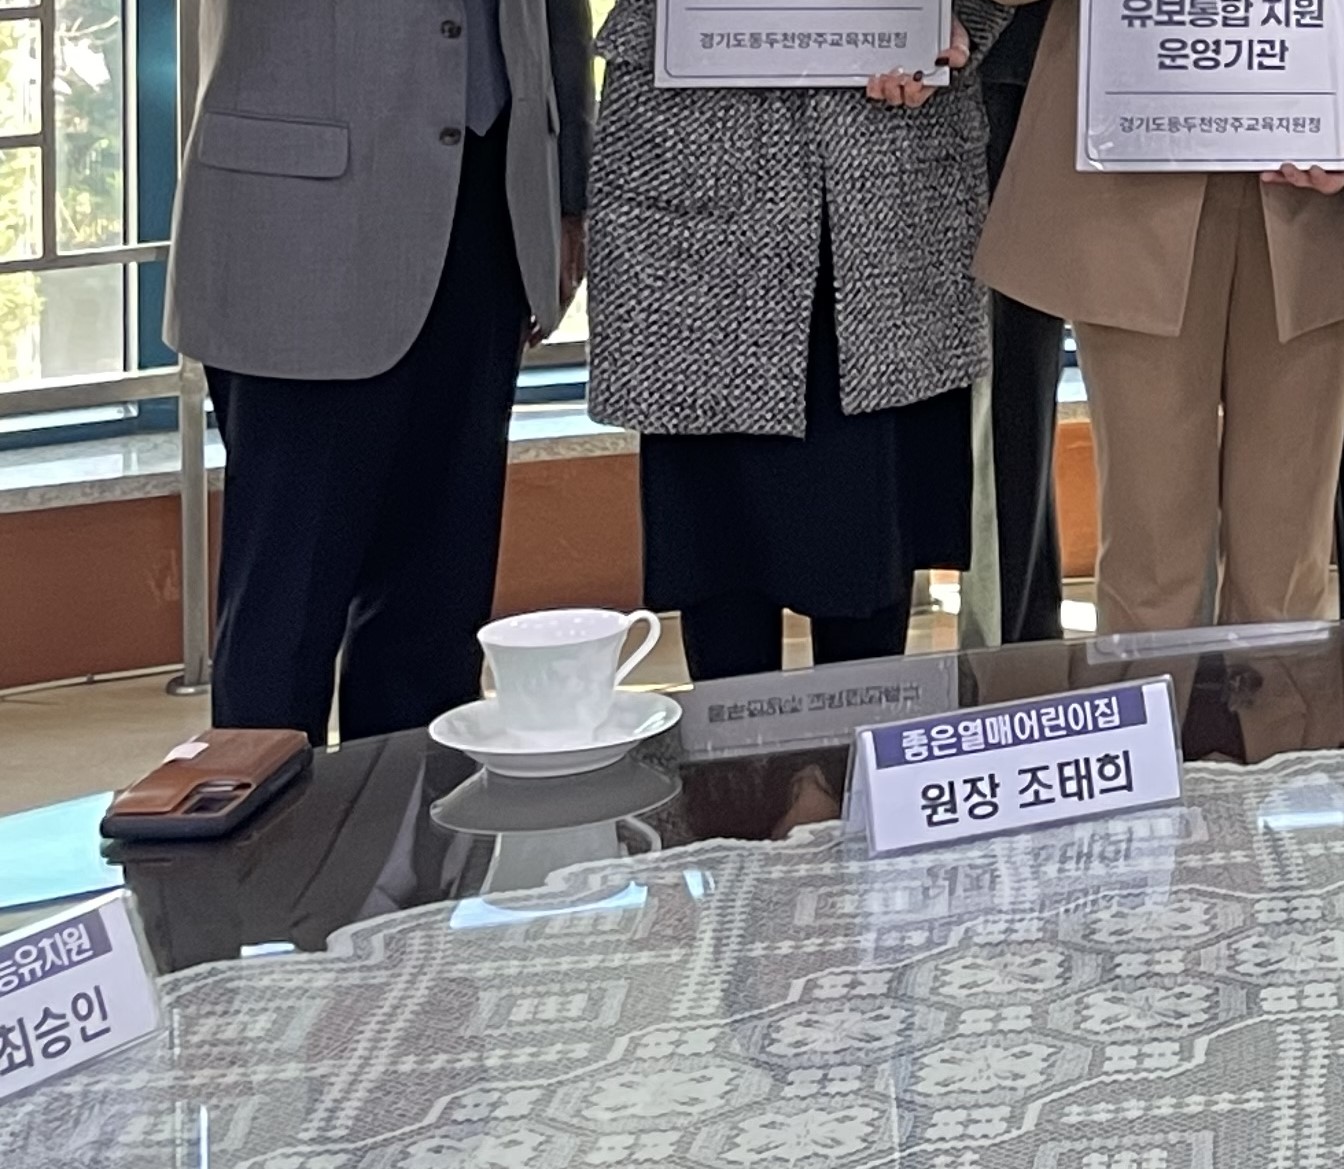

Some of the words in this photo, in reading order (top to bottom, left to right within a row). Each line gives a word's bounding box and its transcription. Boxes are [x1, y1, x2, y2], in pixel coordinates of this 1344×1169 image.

[700, 32, 908, 49] 경기도동두천양주교육지원청
[1157, 38, 1289, 71] 운영기관
[1119, 117, 1321, 133] 경기도동두천양주교육지원청
[902, 696, 1121, 762] 좋은열매어린이집
[920, 773, 1000, 828] 원장
[1017, 750, 1134, 809] 조태희
[0, 985, 111, 1076] 최승인
